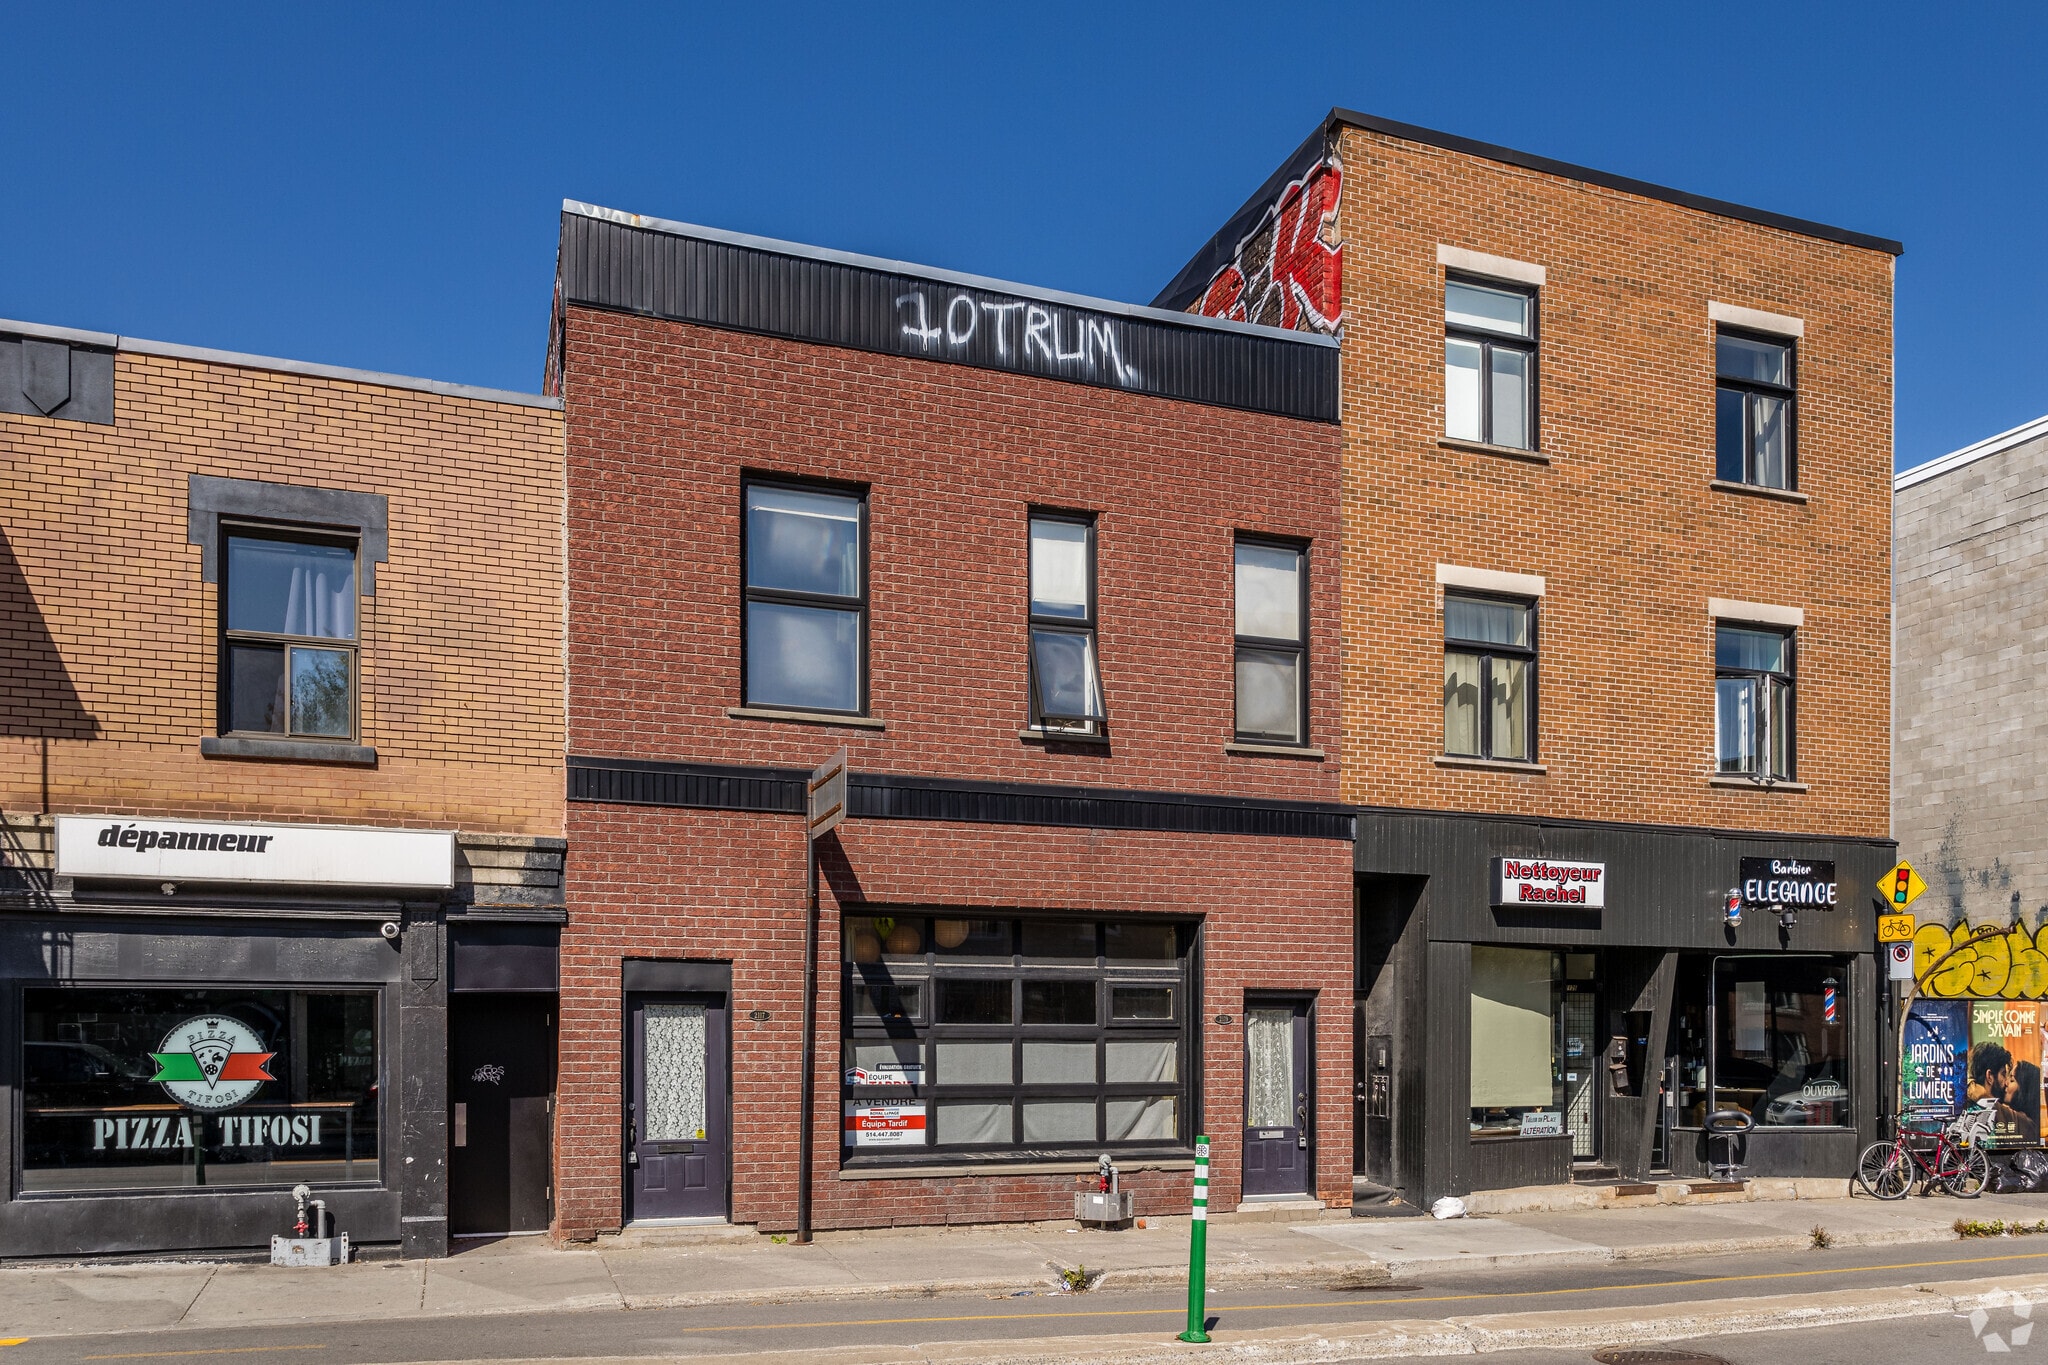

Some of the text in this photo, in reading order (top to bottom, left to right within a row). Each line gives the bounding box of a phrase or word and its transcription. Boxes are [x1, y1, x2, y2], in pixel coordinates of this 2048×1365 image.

[98, 824, 273, 852] dépanneur
[1505, 860, 1602, 885] Nettoyeur
[1771, 860, 1811, 875] Barbier
[1519, 883, 1586, 903] Rachel
[1744, 879, 1837, 904] ELEGANCE
[1973, 1010, 2035, 1024] SIMPLE COMME
[187, 1030, 237, 1045] PIZZA
[1988, 1024, 2021, 1037] SYLVAIN
[1910, 1044, 1954, 1063] JARDINS
[1926, 1066, 1935, 1077] DE
[188, 1089, 239, 1104] TIFOSI
[1803, 1085, 1837, 1097] OUVERT
[862, 1119, 886, 1128] Équipe
[93, 1115, 321, 1149] PIZZA TIFOSI
